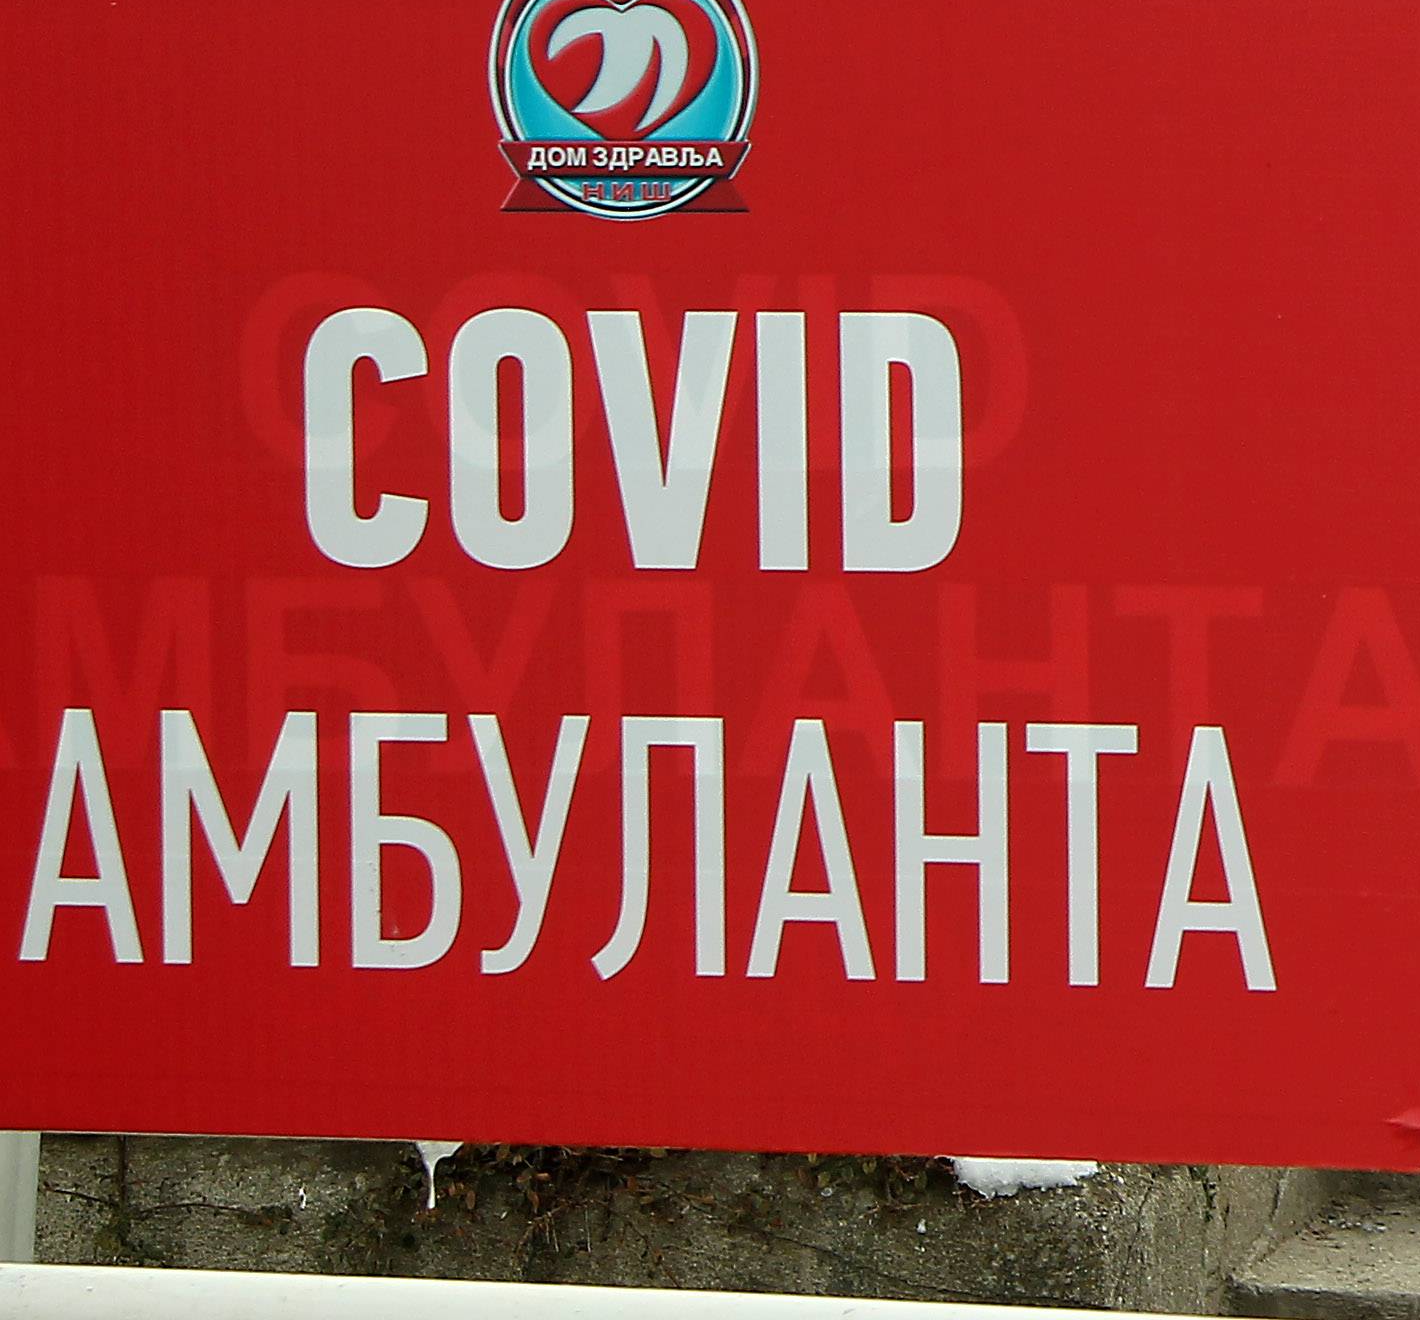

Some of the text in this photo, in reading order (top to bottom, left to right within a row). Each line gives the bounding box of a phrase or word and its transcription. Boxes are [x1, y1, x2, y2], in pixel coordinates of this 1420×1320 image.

[527, 146, 724, 171] ДОМ ЗДРАВЉА
[581, 181, 672, 202] НИШ
[303, 307, 963, 573] COVID
[18, 708, 1277, 992] АМБУЛАНТА
